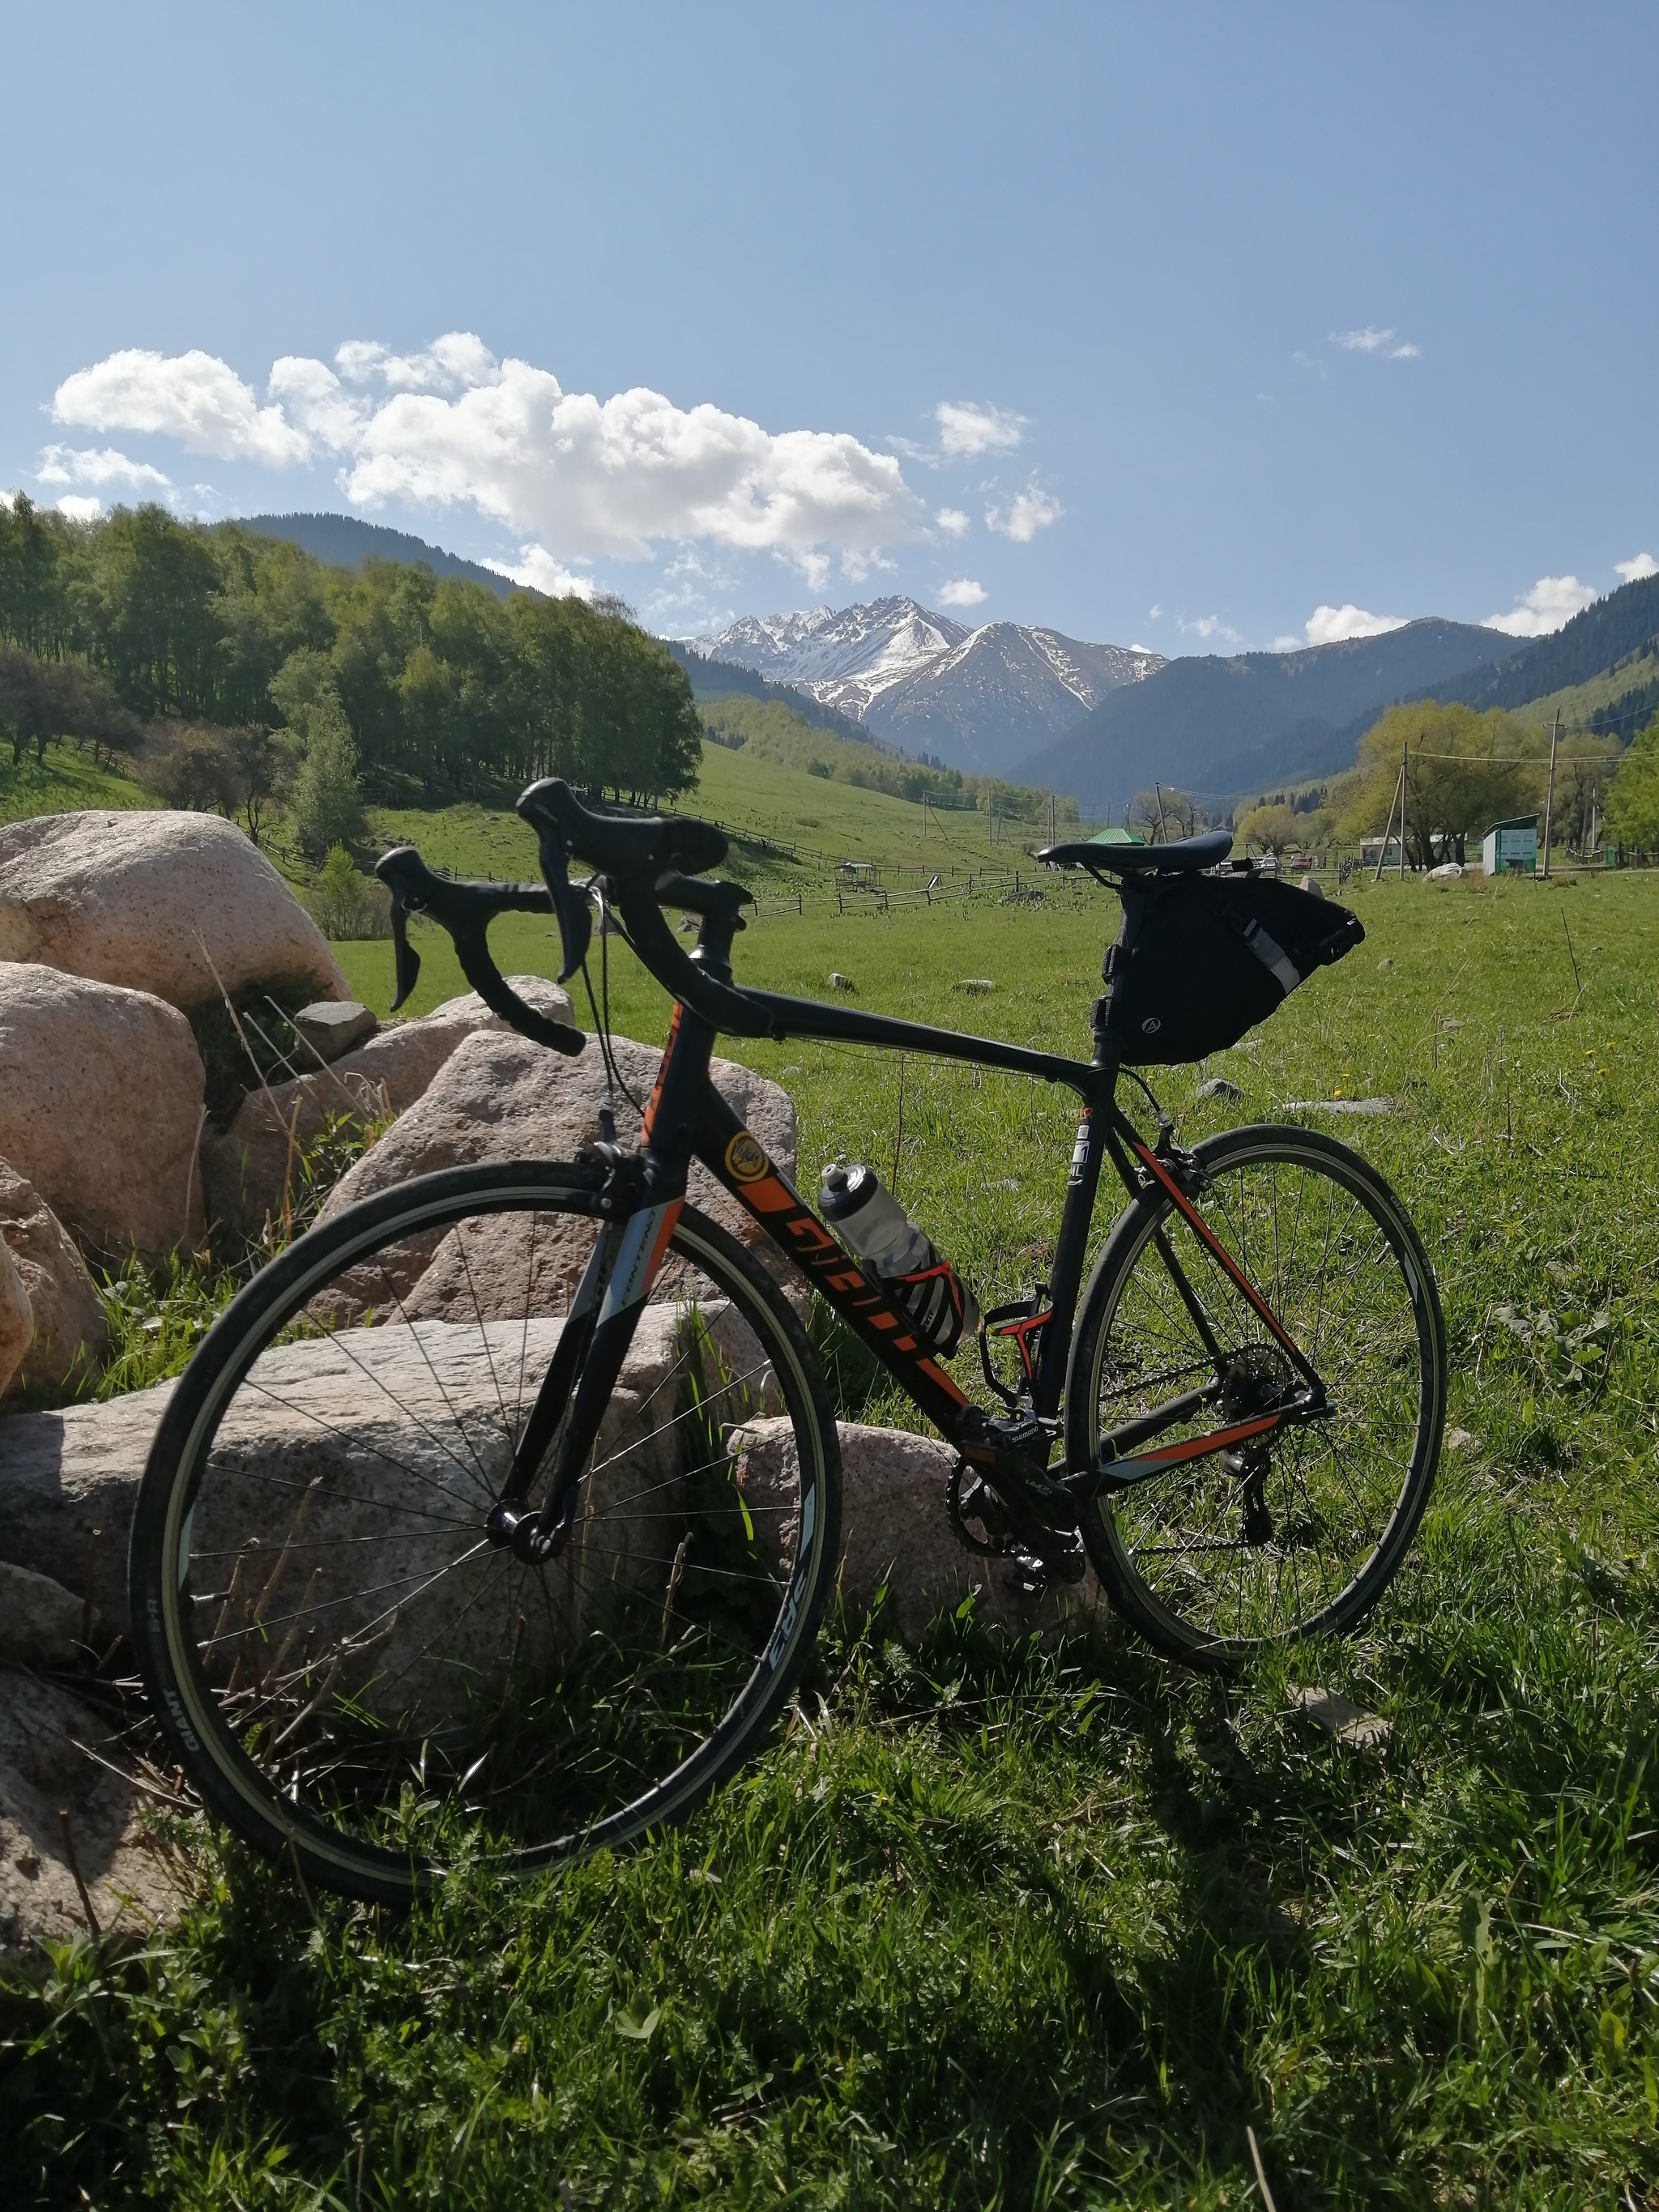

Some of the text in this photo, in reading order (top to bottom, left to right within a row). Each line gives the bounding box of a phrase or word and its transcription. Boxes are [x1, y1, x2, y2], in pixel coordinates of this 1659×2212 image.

[622, 1211, 655, 1306] CONTEND
[1012, 1426, 1038, 1443] SHIMANO
[164, 1688, 200, 1752] GIANT
